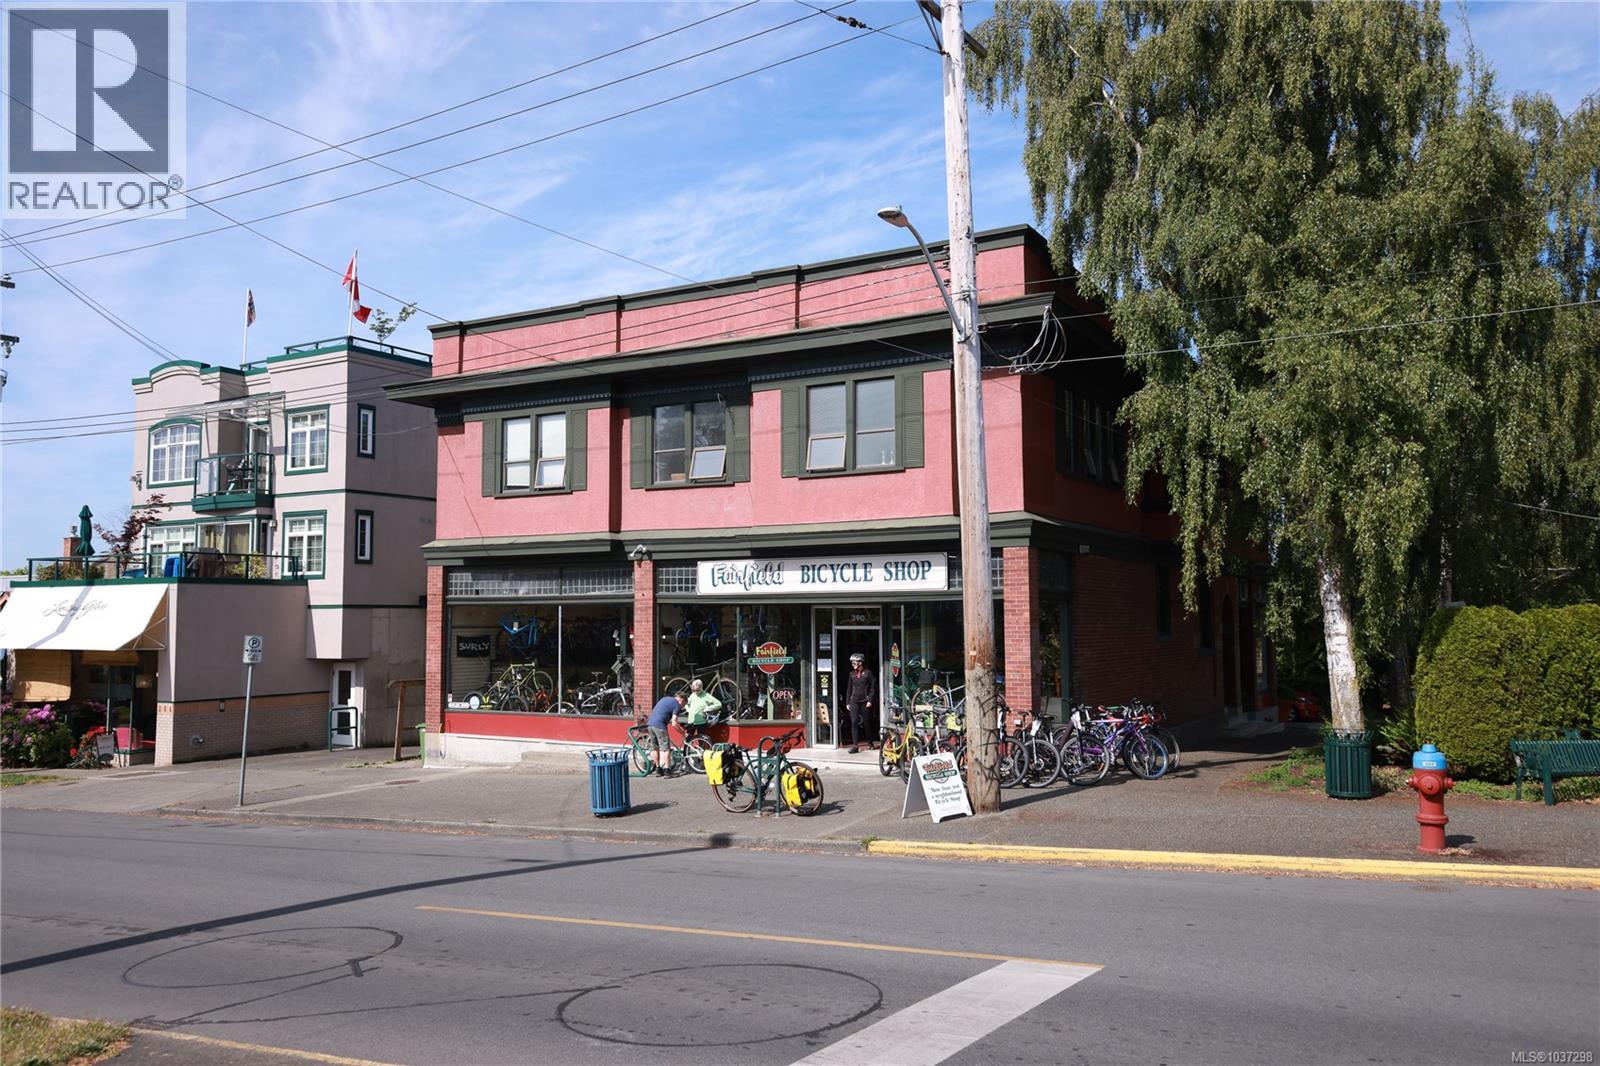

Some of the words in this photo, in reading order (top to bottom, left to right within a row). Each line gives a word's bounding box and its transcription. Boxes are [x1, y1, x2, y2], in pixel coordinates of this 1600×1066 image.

[711, 561, 785, 591] Fairfield
[800, 562, 873, 584] BICYCLE
[883, 560, 932, 582] SHOP
[459, 642, 490, 651] SURLY
[756, 646, 787, 657] Fairfield
[772, 690, 796, 700] OPEN
